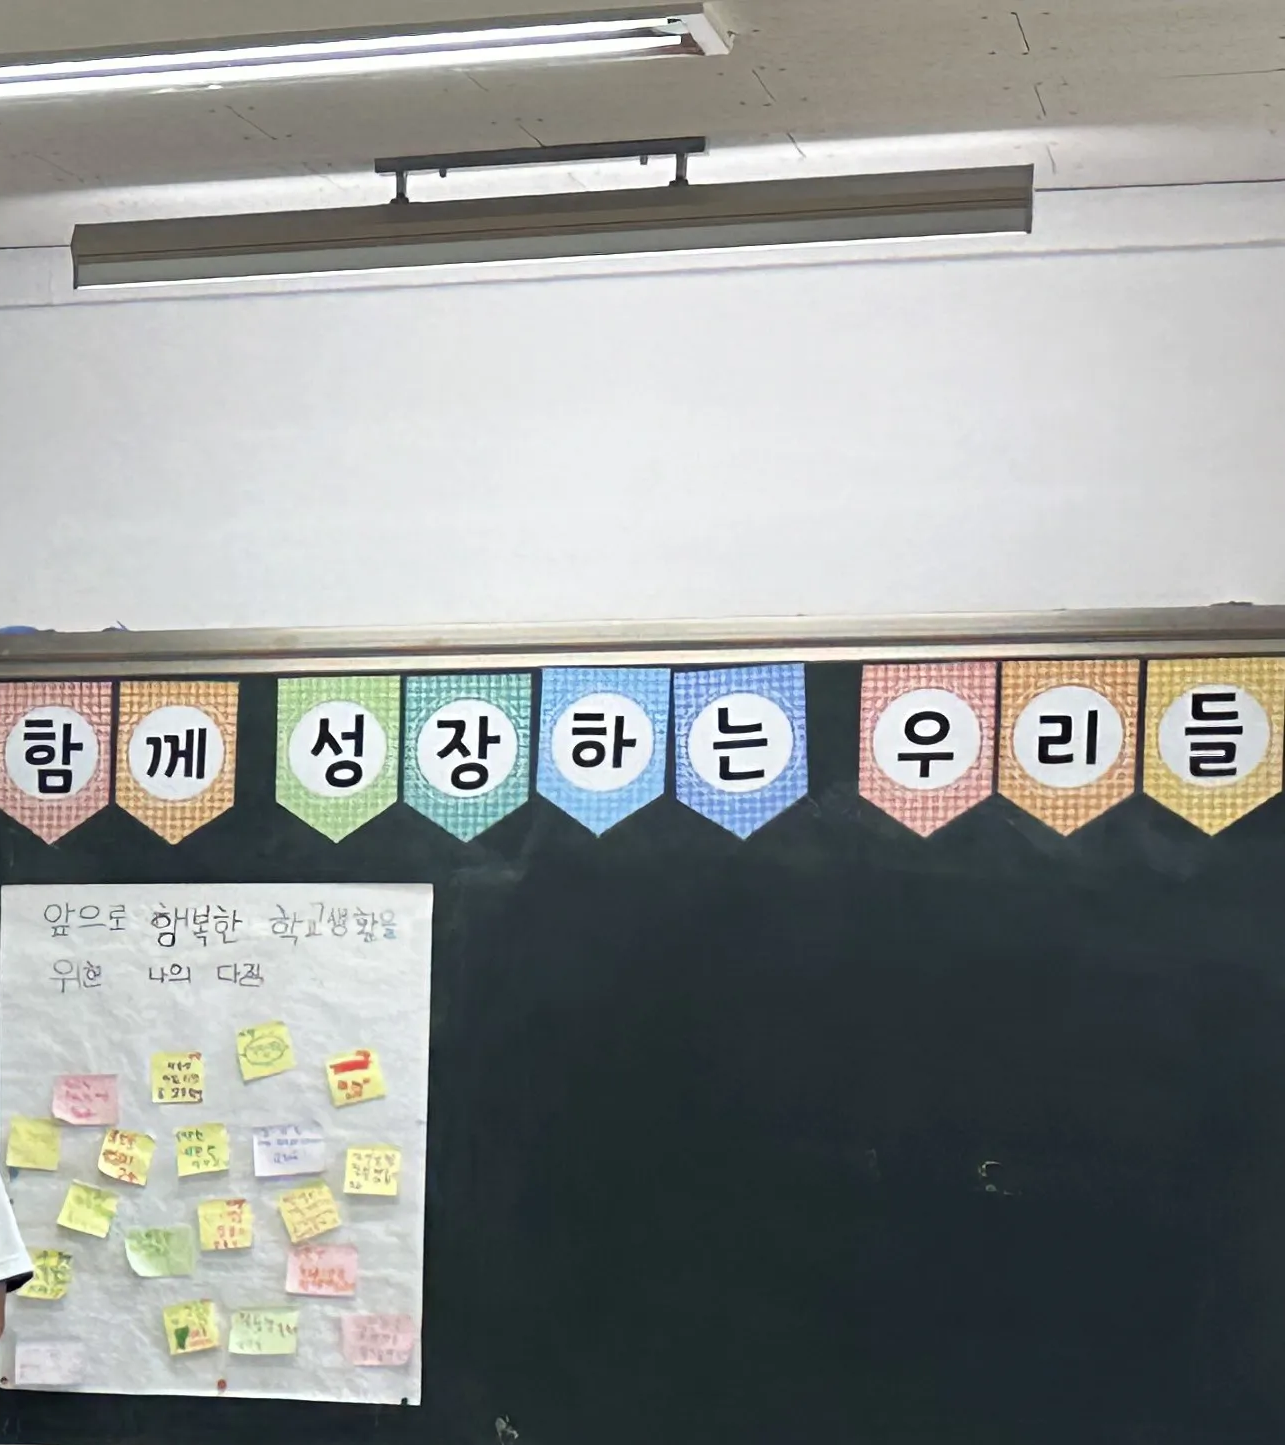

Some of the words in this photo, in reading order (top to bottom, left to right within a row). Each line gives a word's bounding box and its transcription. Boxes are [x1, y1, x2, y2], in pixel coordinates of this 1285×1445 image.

[23, 719, 207, 794] 함께
[311, 706, 768, 790] 성장하는
[898, 692, 1243, 779] 우리들
[44, 903, 127, 937] 앞으로
[149, 963, 192, 984] 나의
